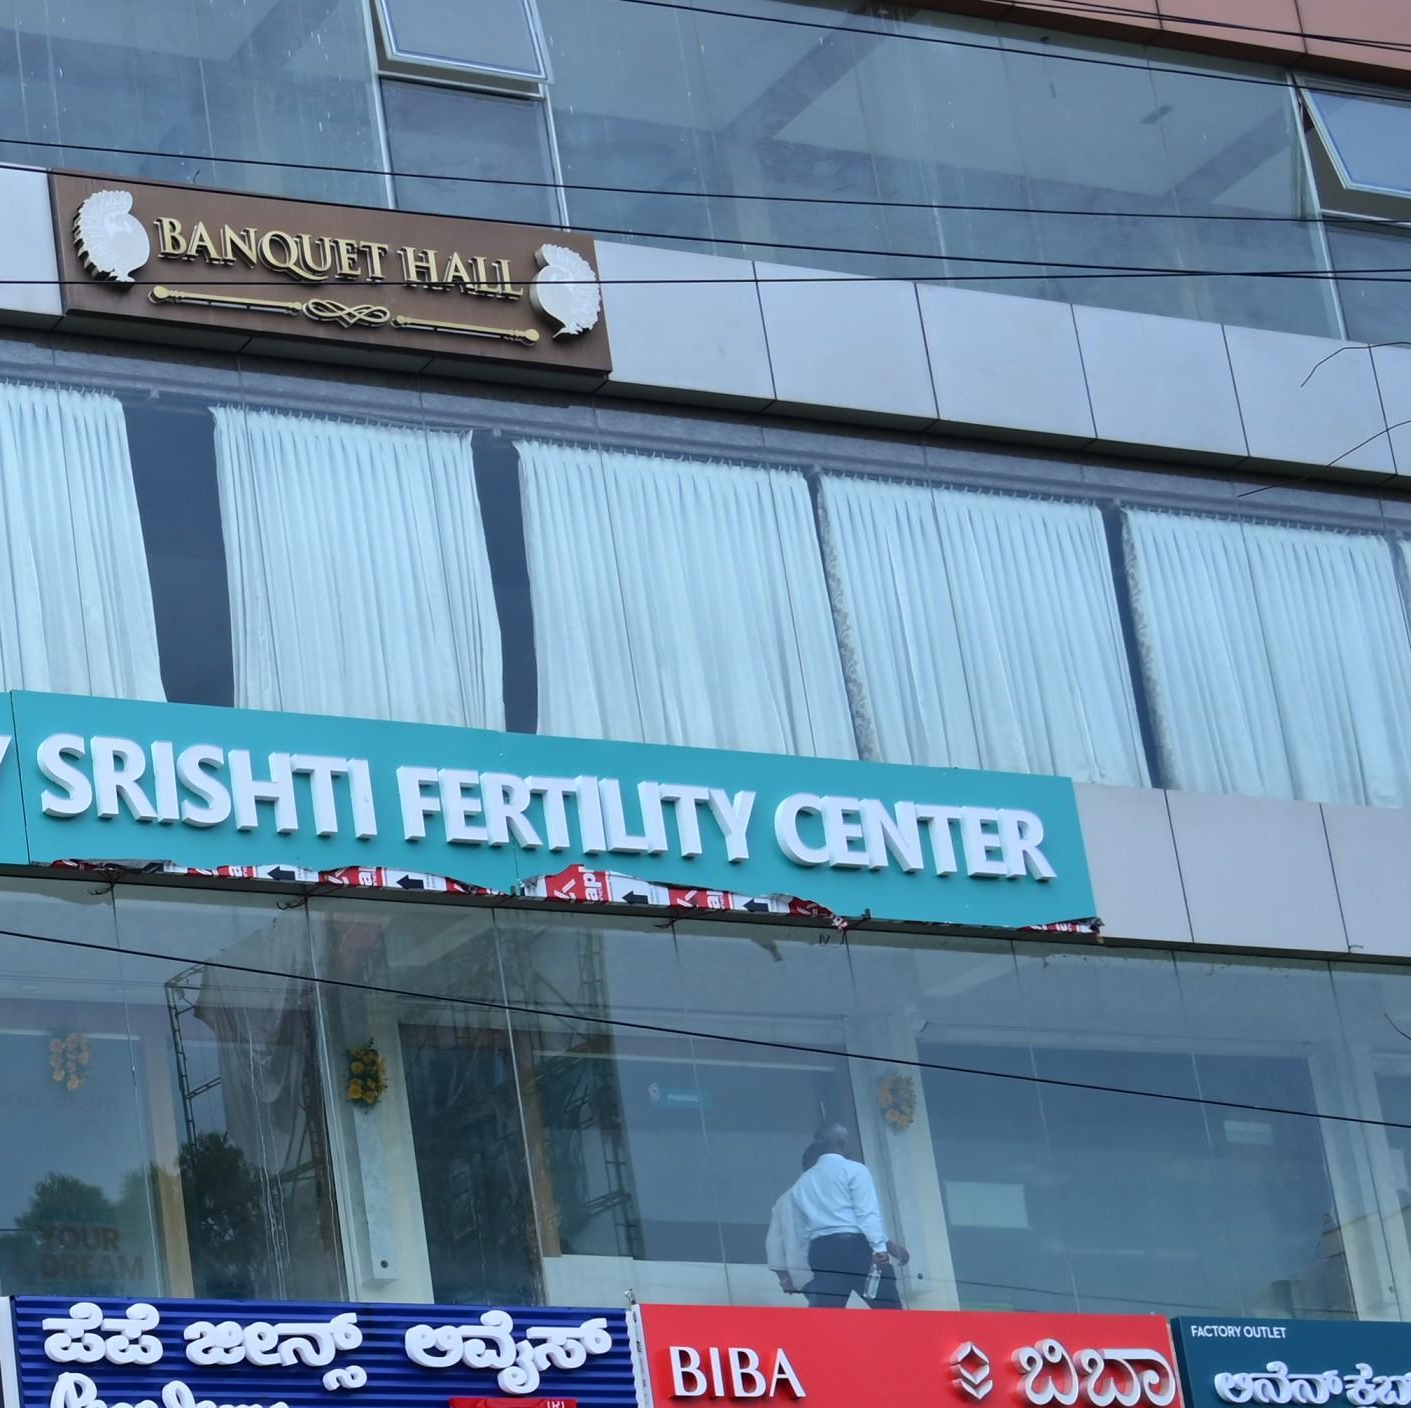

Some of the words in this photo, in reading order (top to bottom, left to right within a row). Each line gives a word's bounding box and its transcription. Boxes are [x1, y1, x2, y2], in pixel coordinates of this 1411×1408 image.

[154, 216, 388, 282] BANQUET
[397, 246, 524, 299] HALL
[36, 732, 378, 841] SRISHTI
[396, 764, 757, 864] FERTILITY
[775, 791, 1058, 882] CENTER
[40, 1254, 145, 1280] DREAM
[41, 1225, 121, 1251] YOUR
[42, 1302, 164, 1365] ಪೆಪೆ
[1191, 1325, 1242, 1338] FACTORY
[1243, 1326, 1286, 1339] OUTLET
[667, 1344, 807, 1400] BIBA
[1014, 1338, 1178, 1408] ಬಿಬಾ
